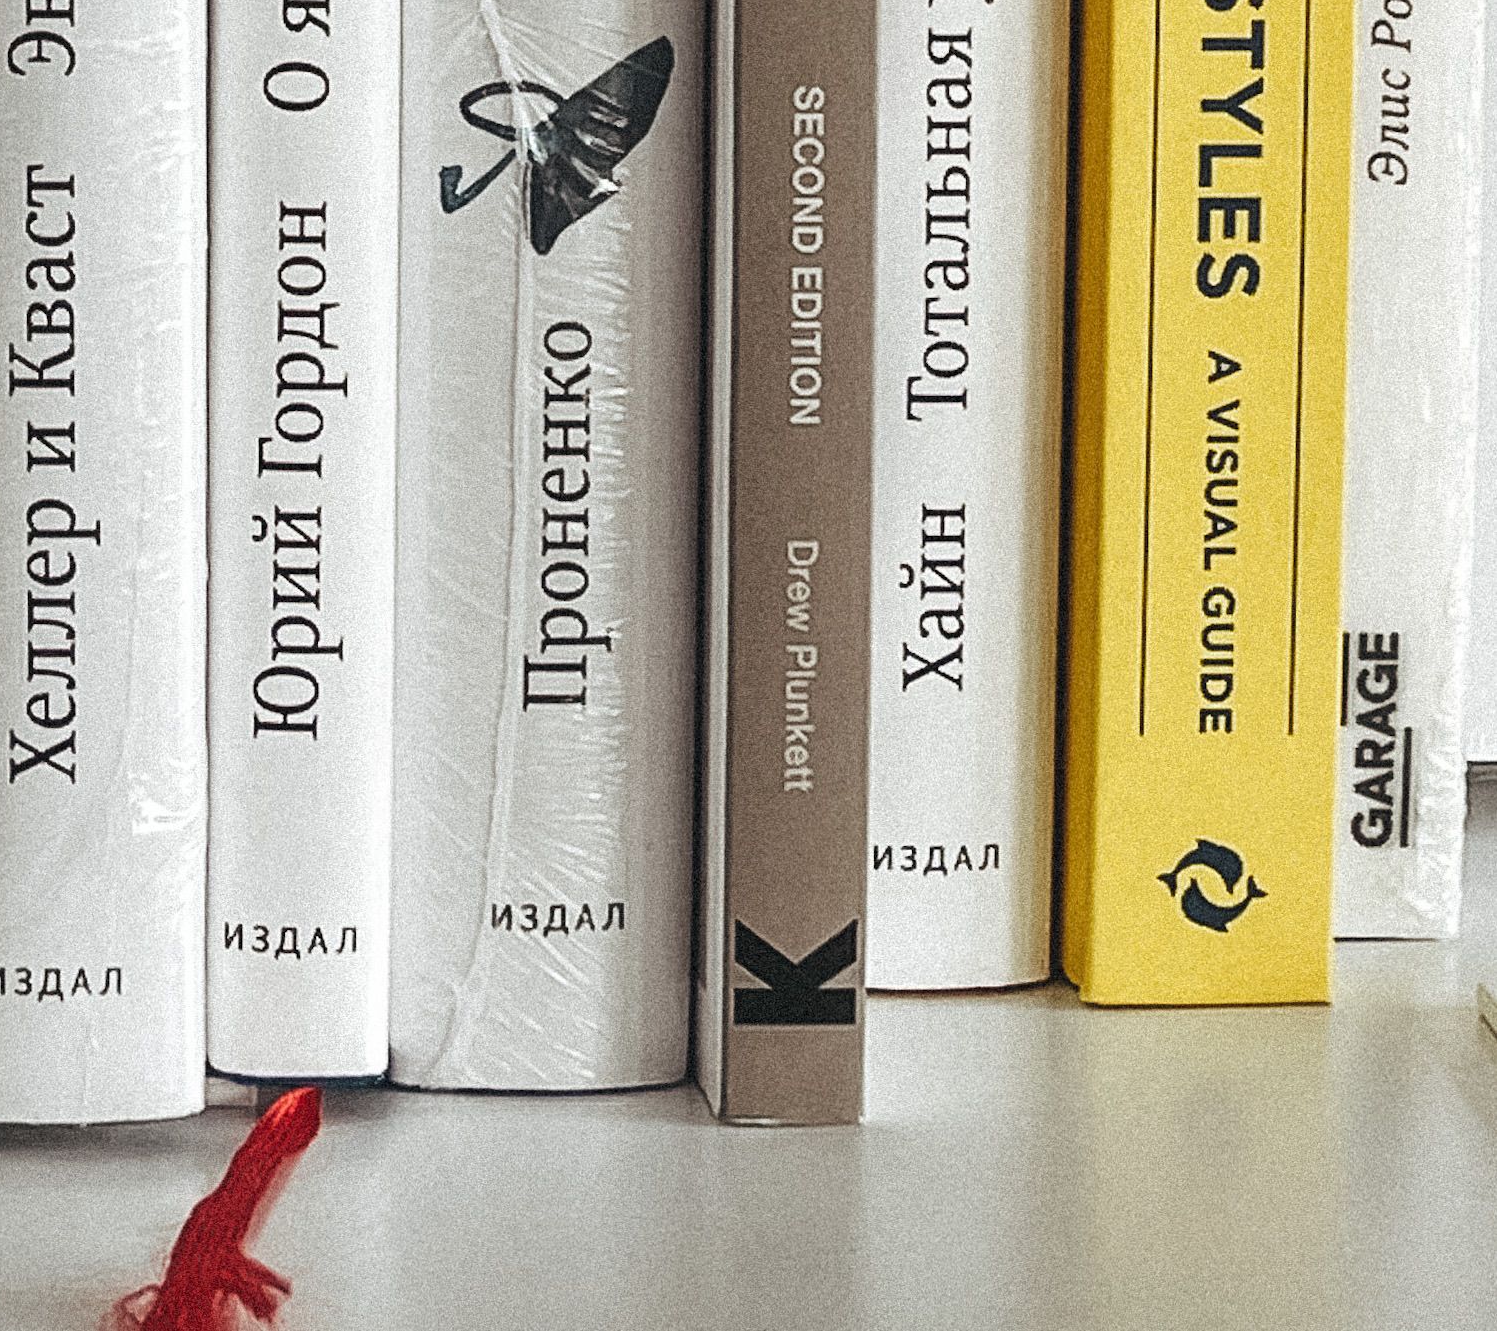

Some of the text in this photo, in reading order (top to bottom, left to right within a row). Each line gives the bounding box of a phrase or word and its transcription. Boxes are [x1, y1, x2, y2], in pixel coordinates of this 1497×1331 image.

[264, 62, 330, 113] О
[1368, 66, 1411, 185] Элис
[8, 164, 77, 396] Кваст
[788, 84, 826, 425] SECOND EDITION
[905, 27, 972, 421] Тотальная
[27, 422, 77, 473] и
[257, 201, 348, 477] Гордон
[252, 505, 343, 740] Юрий
[522, 319, 613, 712] Проненко
[898, 503, 965, 691] Хайн
[1199, 350, 1243, 735] A VISUAL GUIDE
[9, 497, 101, 784] Хеллер
[783, 540, 819, 792] Drew Plunkett
[1351, 631, 1400, 849] GARAGE
[223, 922, 358, 960] ИЗДАЛ
[491, 902, 626, 937] ИЗДАЛ
[733, 918, 859, 1026] K
[872, 844, 1001, 876] ИЗДАЛ
